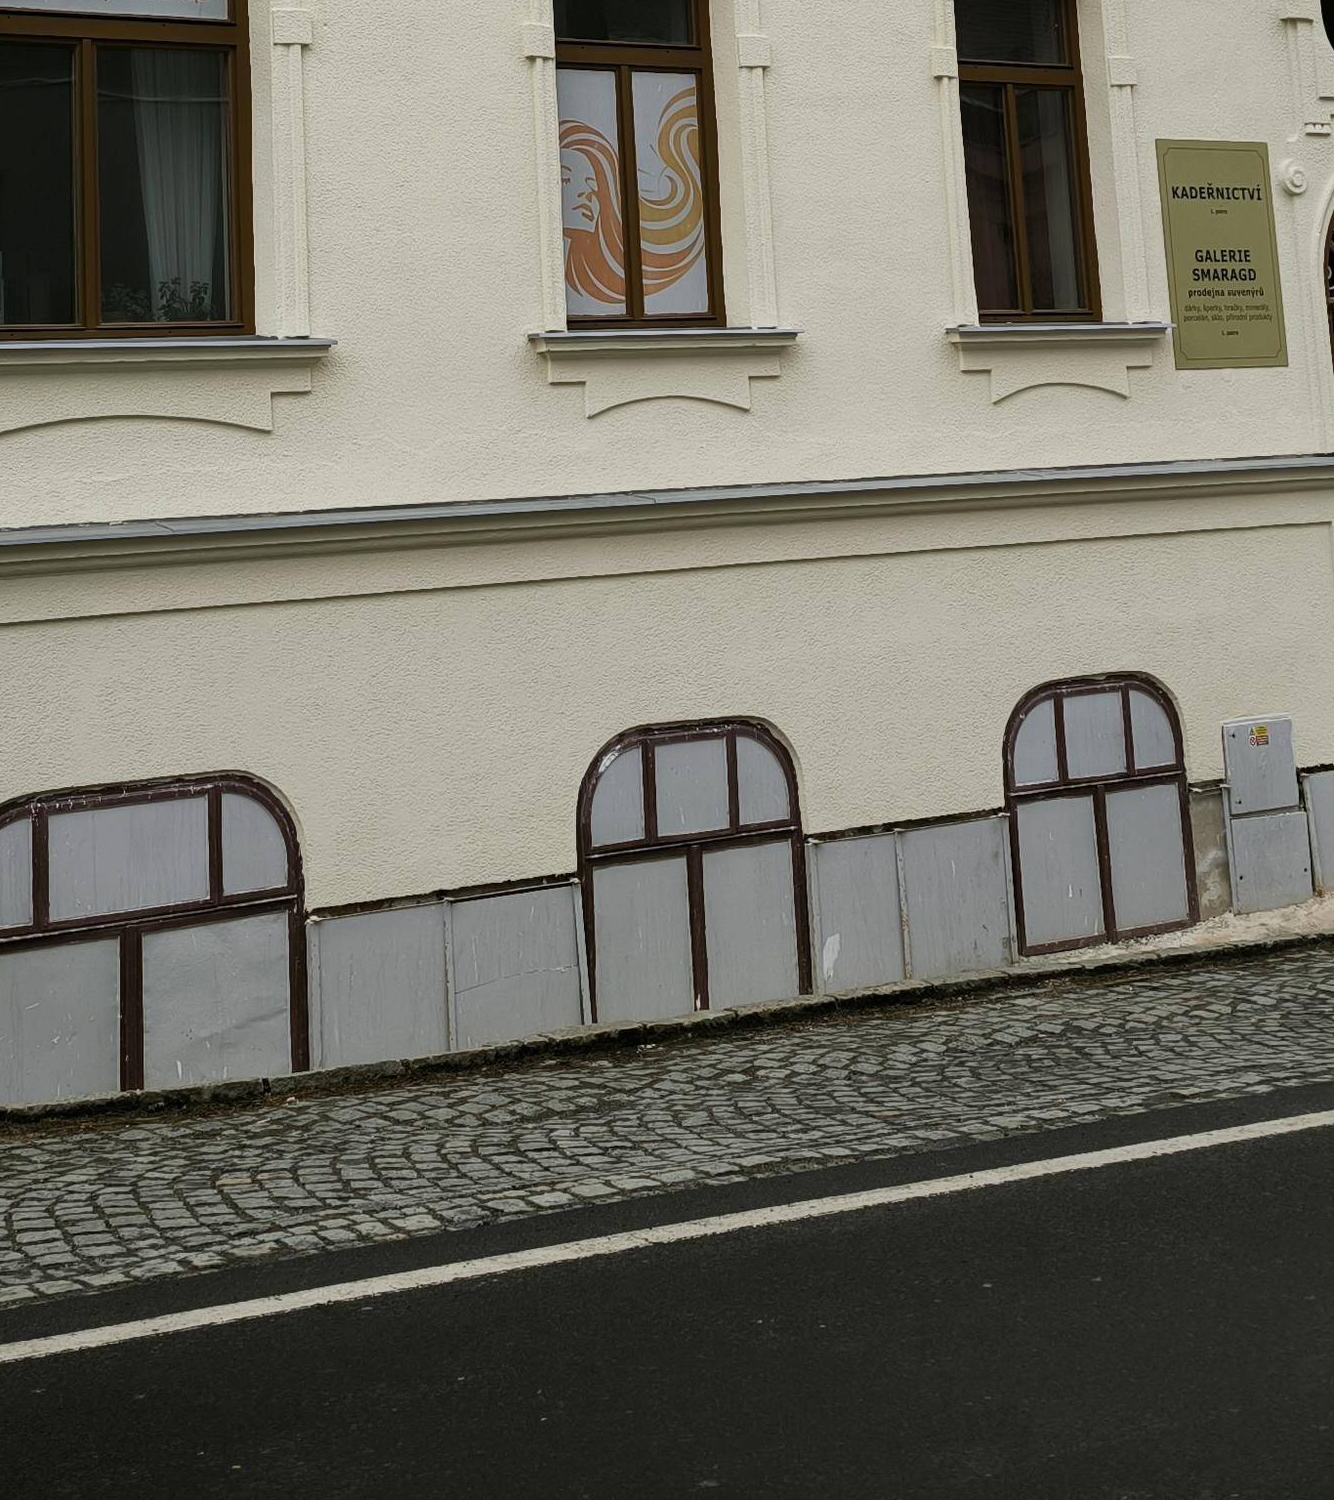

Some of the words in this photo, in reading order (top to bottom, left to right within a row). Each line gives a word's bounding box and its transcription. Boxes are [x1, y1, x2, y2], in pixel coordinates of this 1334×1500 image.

[1172, 182, 1262, 200] KADEŘNICTVÍ
[1195, 250, 1251, 263] GALERIE
[1192, 268, 1256, 281] SMARAGD
[1188, 288, 1224, 299] prodejna
[1227, 287, 1264, 298] suvenýrů
